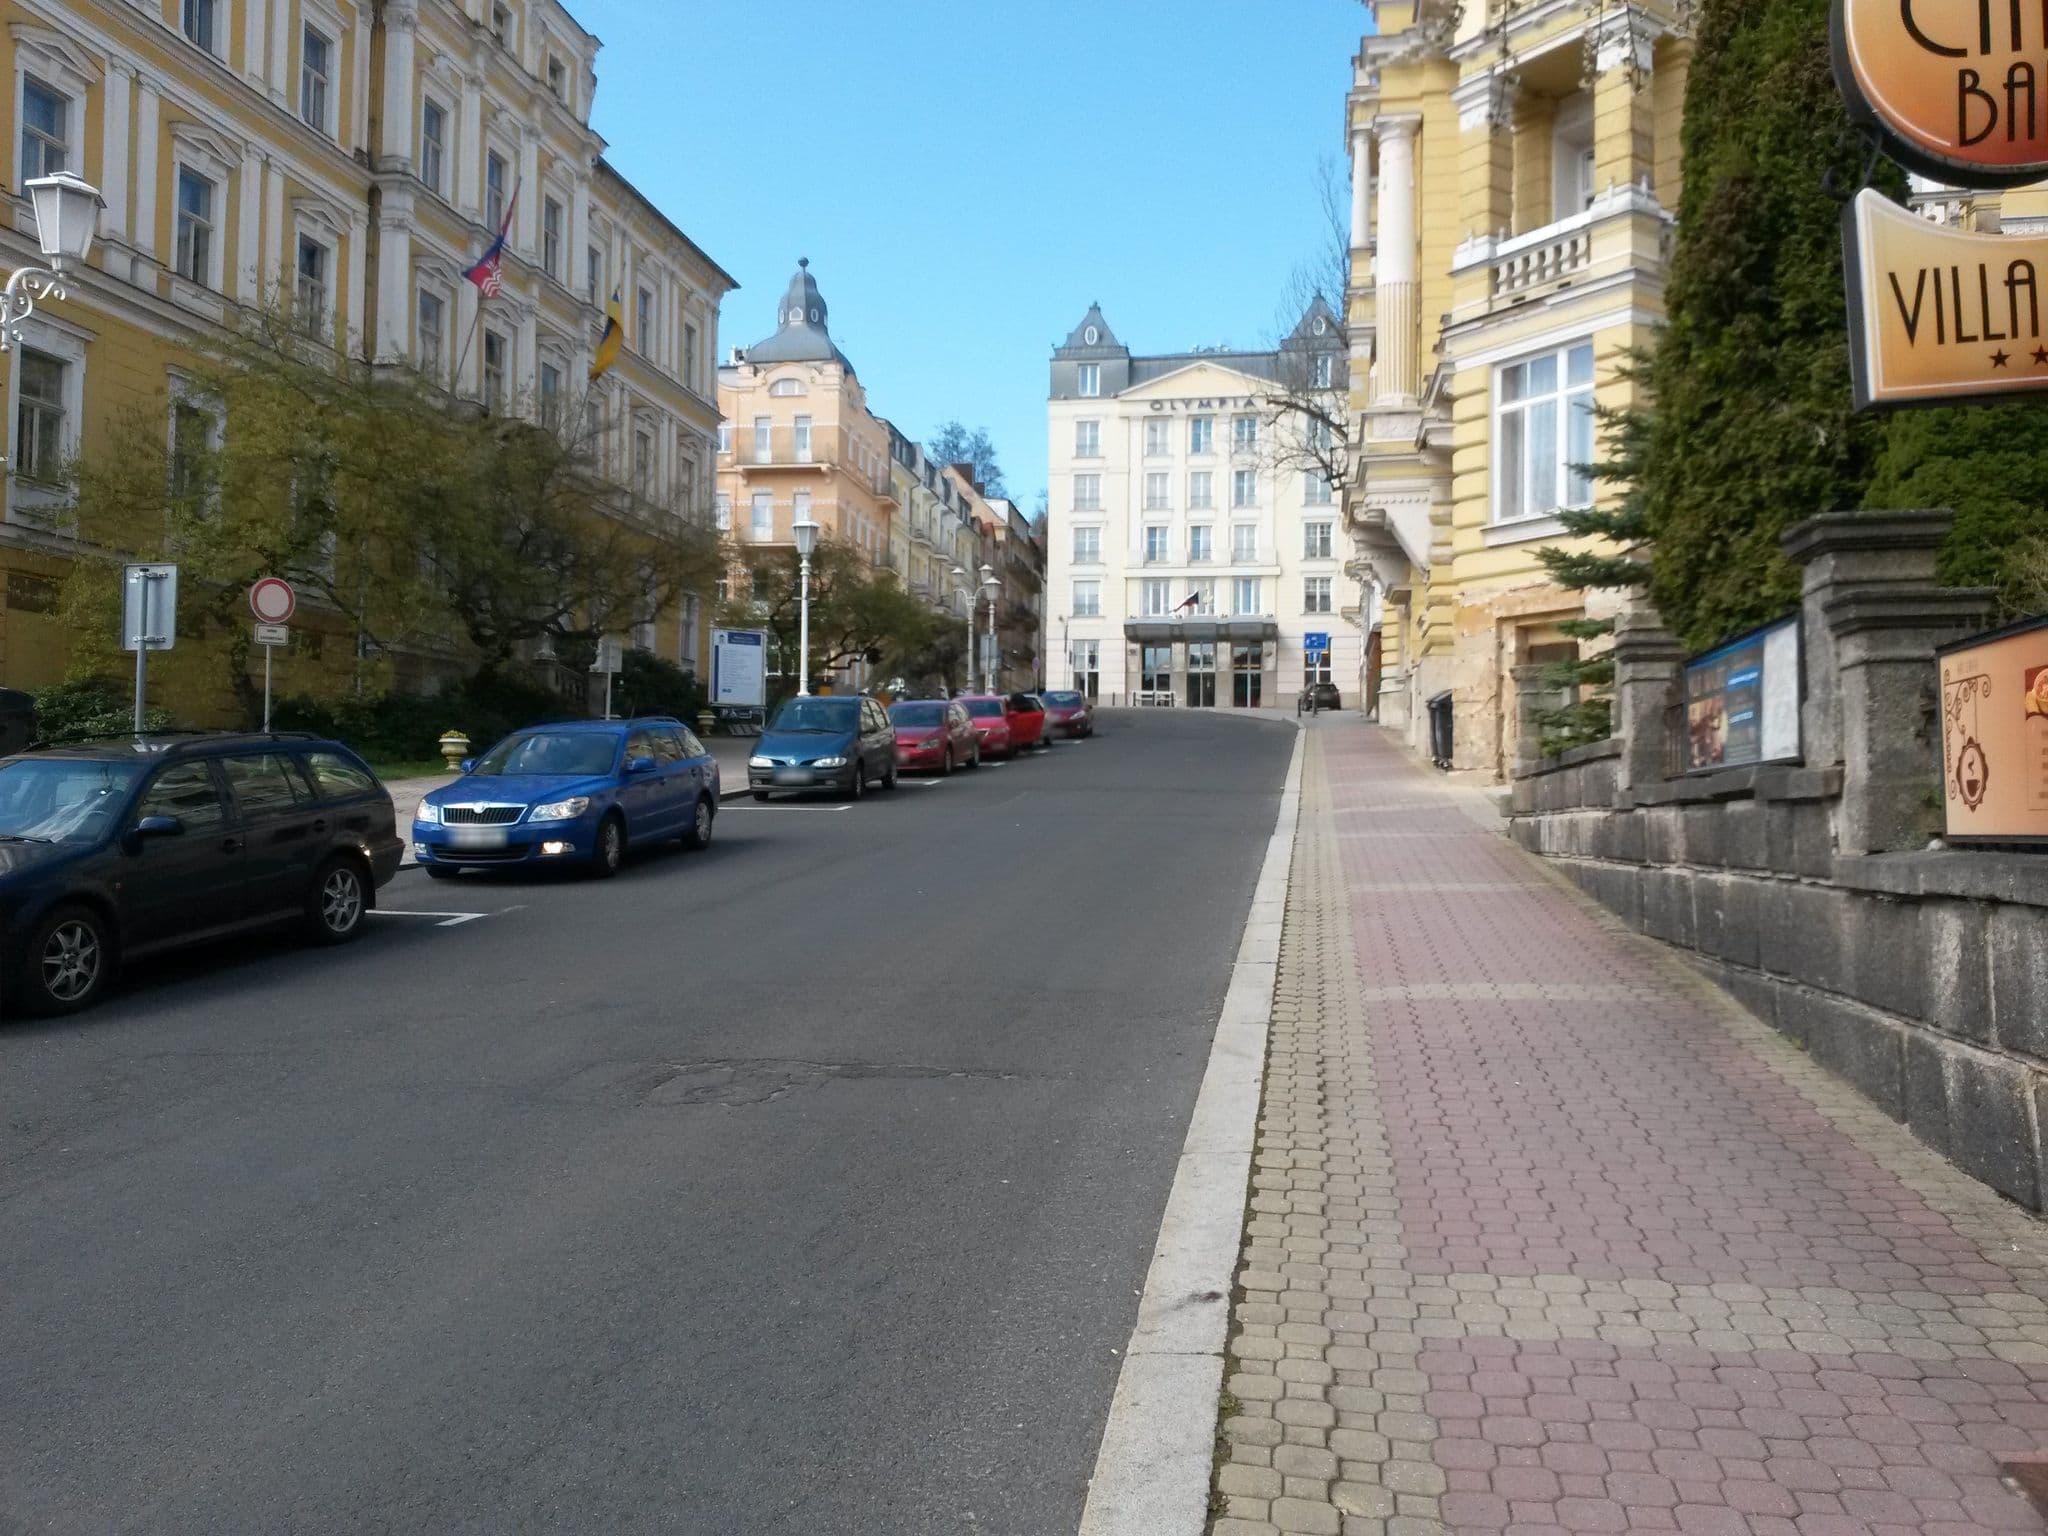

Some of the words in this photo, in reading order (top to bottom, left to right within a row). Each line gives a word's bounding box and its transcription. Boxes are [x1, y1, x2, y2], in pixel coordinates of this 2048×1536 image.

[1958, 60, 2048, 147] BA
[1888, 258, 2039, 347] VILLA
[1149, 396, 1257, 412] OLYMPIA
